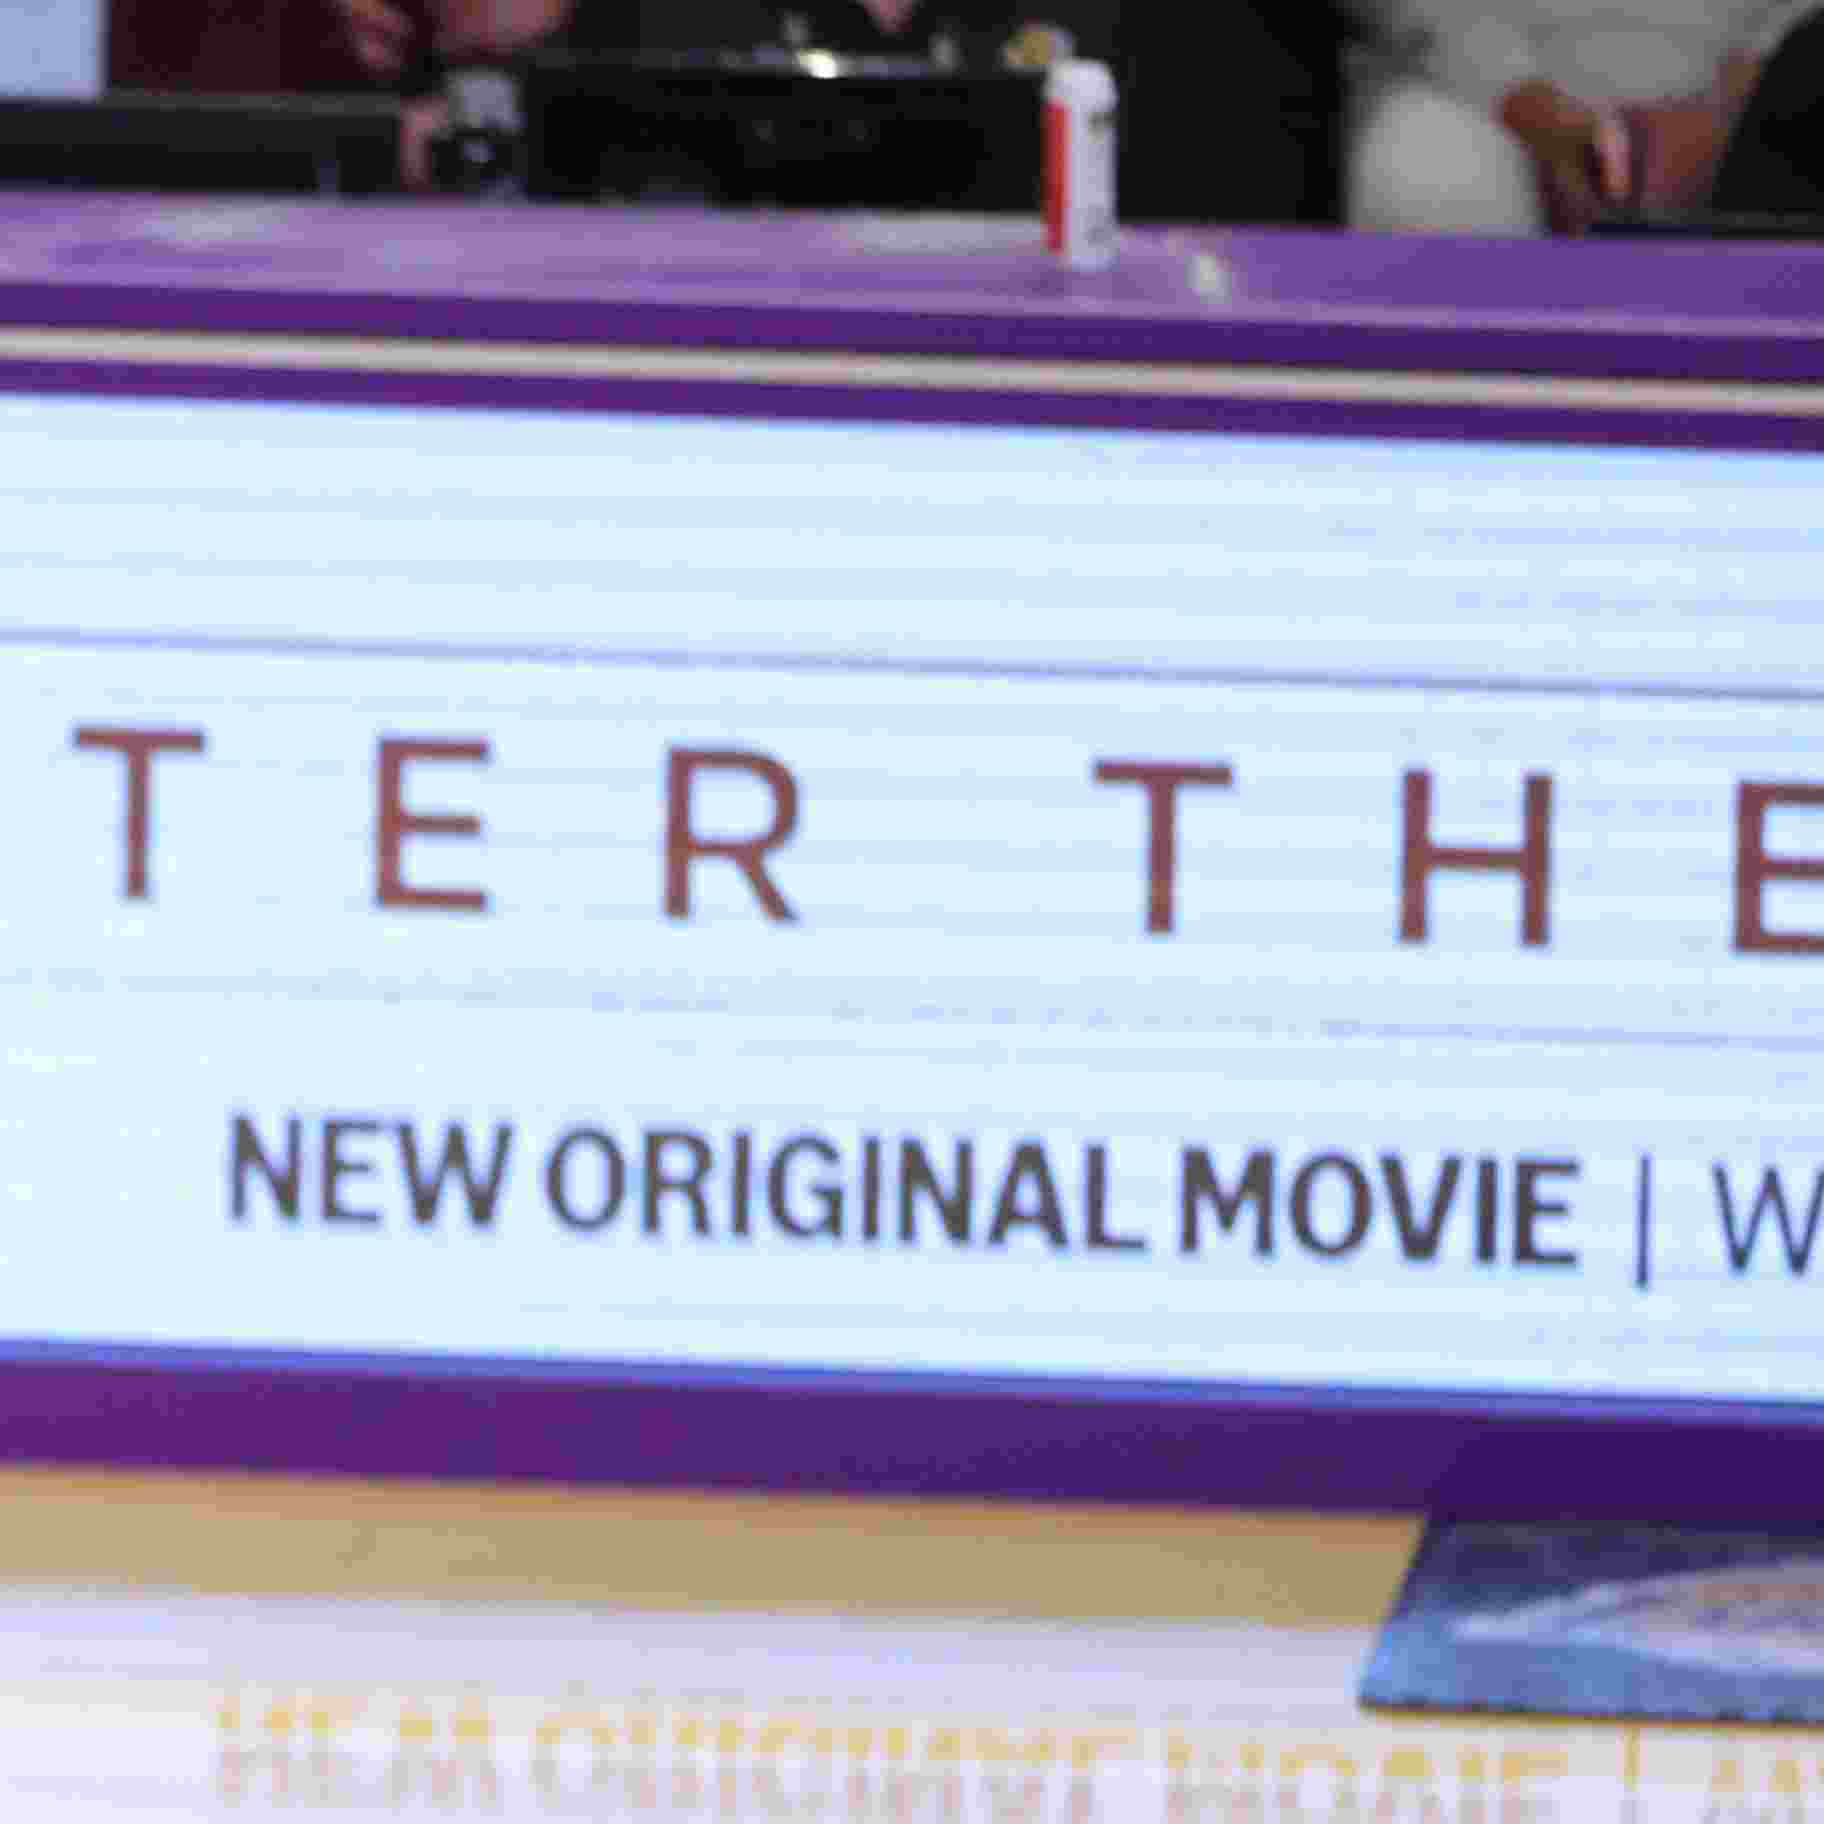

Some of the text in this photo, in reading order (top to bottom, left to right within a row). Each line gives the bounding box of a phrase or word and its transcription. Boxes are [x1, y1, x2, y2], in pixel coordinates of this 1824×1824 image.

[1092, 758, 1824, 956] THE
[227, 1112, 515, 1229] NEW
[545, 1127, 1147, 1254] ORIGINAL
[1178, 1143, 1583, 1267] MOVIE
